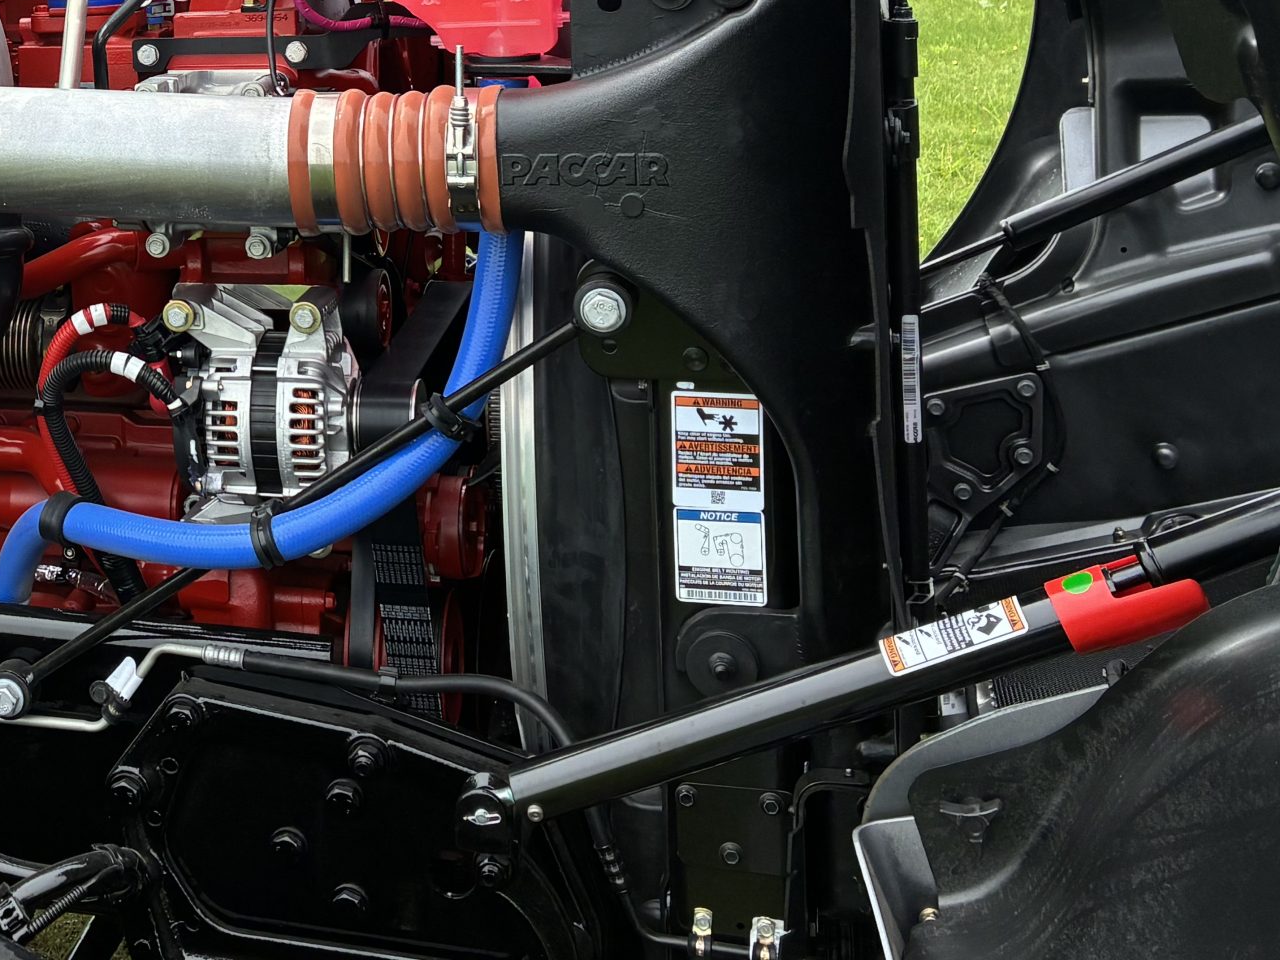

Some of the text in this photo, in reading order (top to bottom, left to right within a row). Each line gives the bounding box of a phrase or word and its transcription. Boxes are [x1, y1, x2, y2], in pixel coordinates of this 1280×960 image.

[501, 153, 669, 186] PACCAR
[702, 398, 742, 406] WARNING
[688, 442, 756, 452] AVERTISSEMENT
[694, 465, 751, 474] ADVERTENCIA
[699, 511, 738, 521] NOTICE
